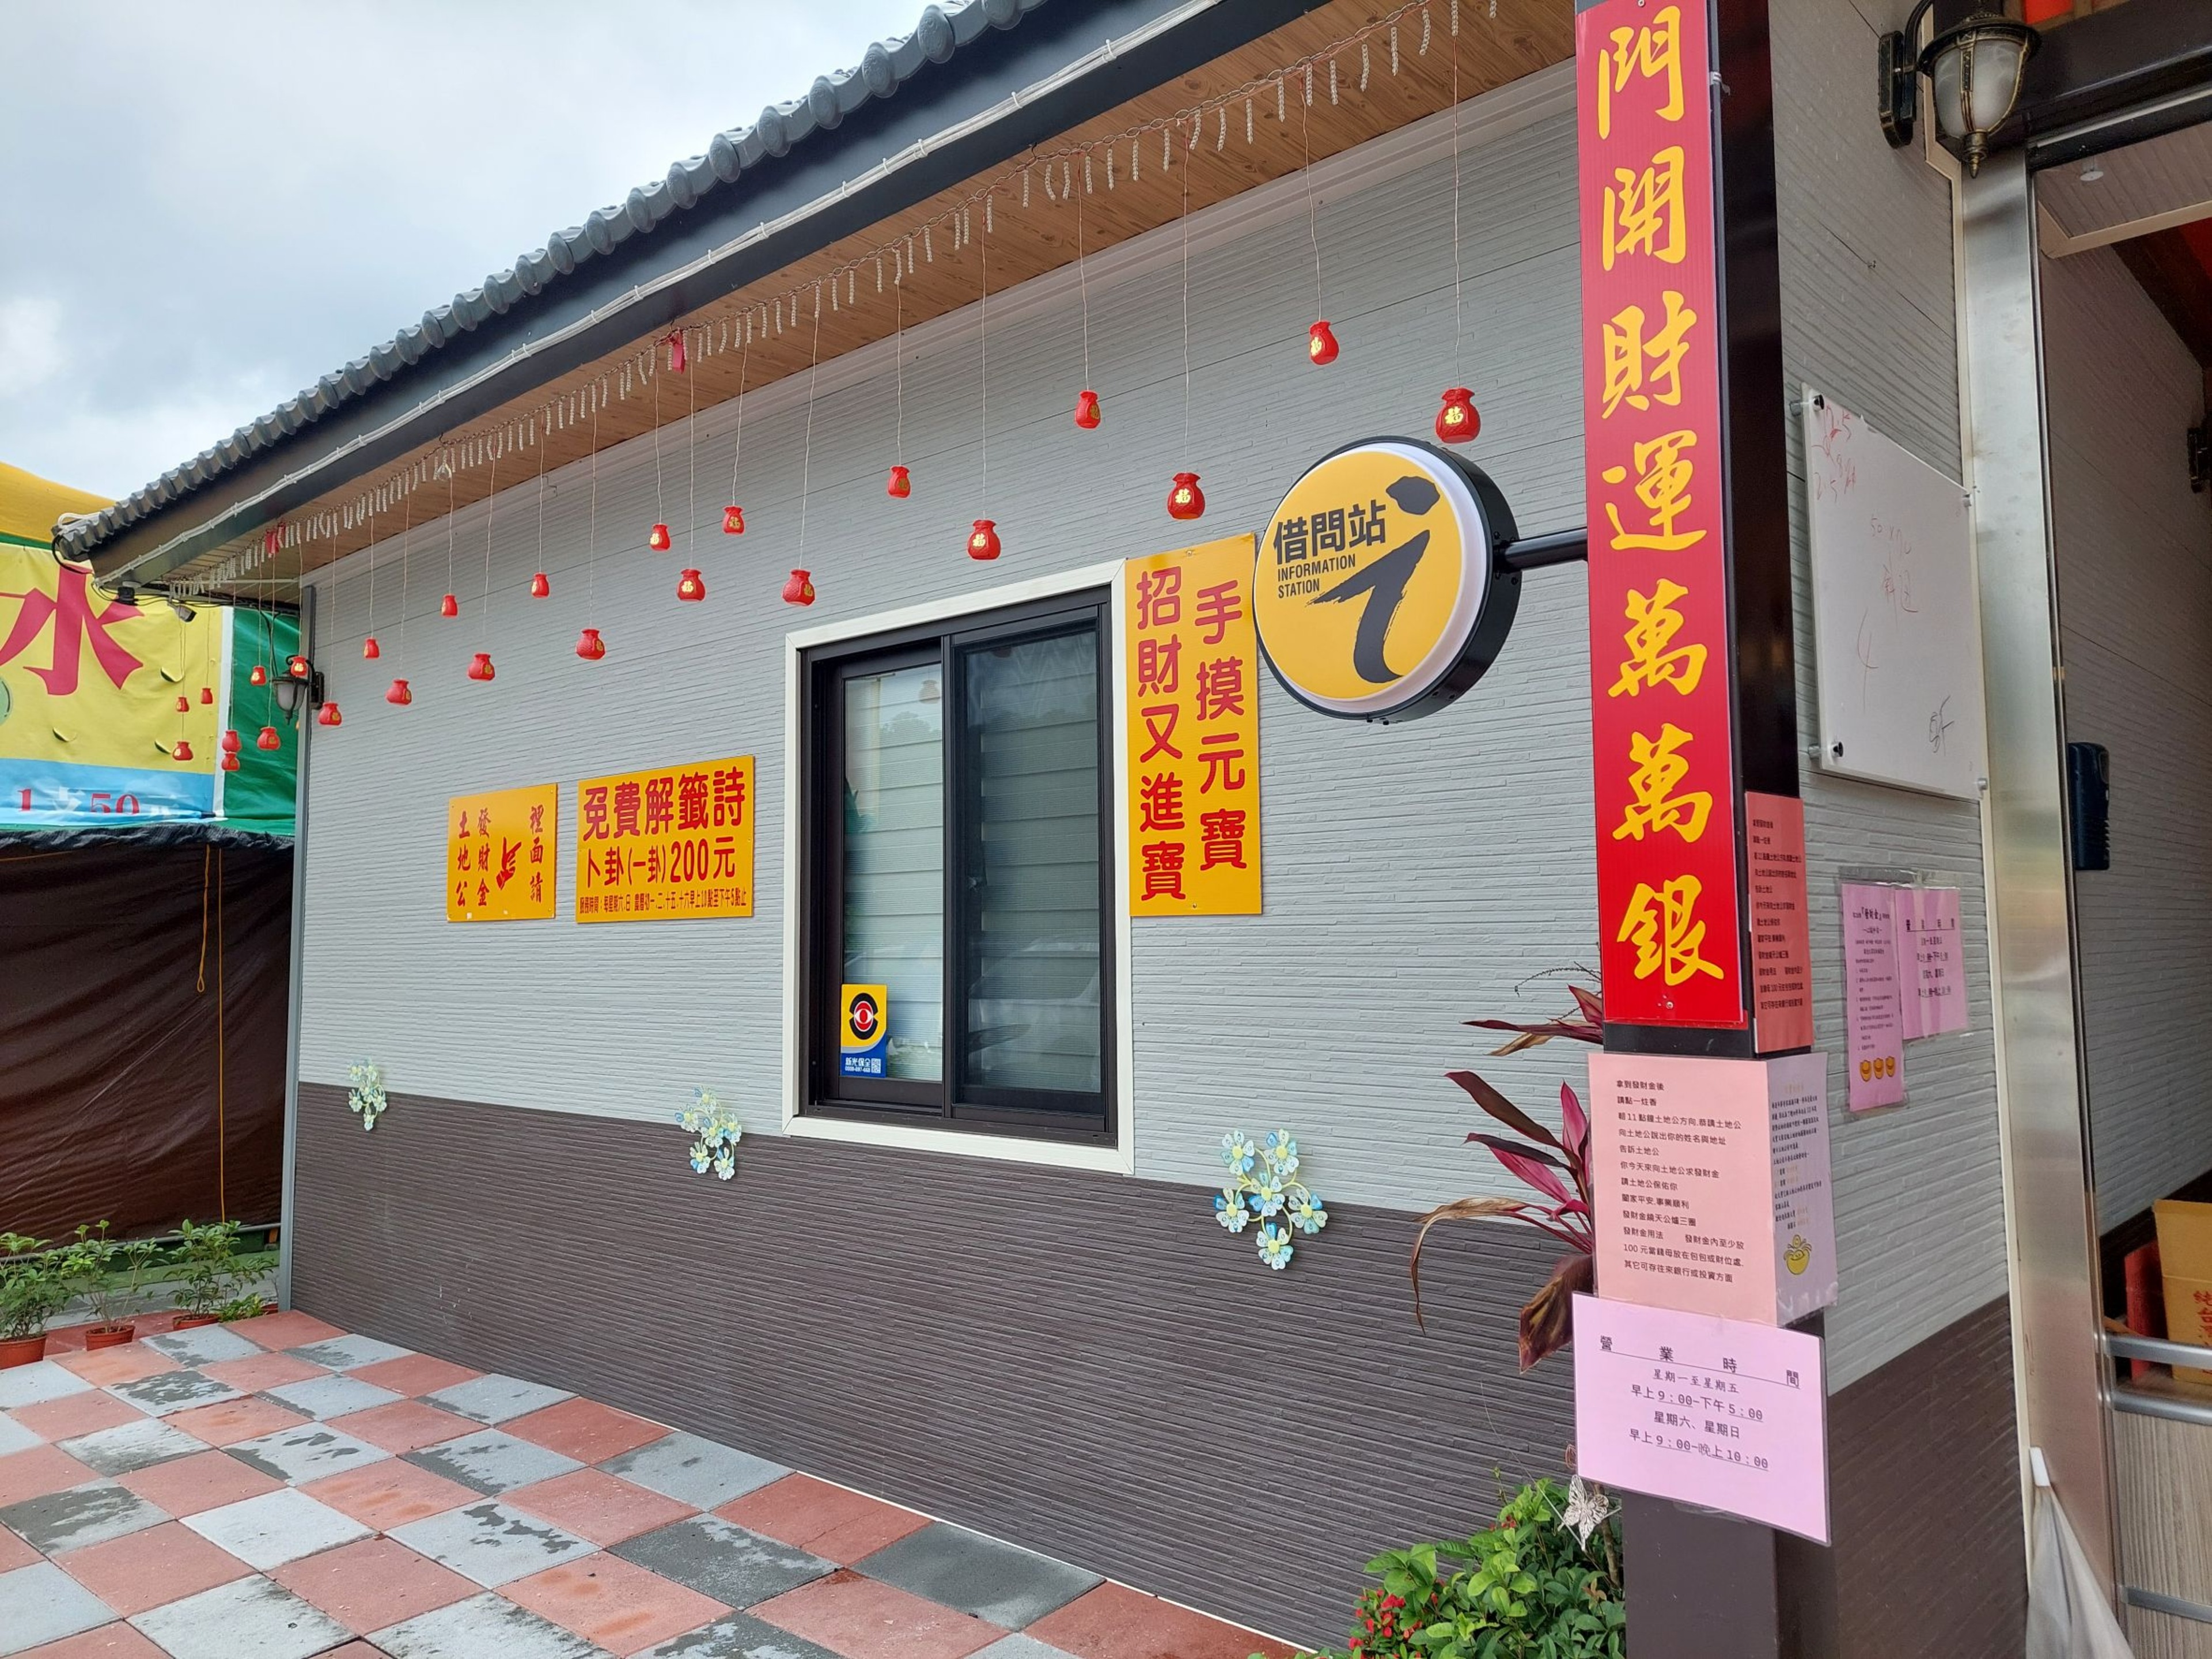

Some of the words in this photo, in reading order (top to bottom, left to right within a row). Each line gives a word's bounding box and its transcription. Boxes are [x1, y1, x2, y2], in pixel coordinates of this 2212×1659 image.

[1598, 5, 1724, 987] 門開財運萬萬銀
[1273, 499, 1387, 565] 借問站
[1277, 554, 1356, 582] INFORMATION
[1278, 578, 1320, 599] STATION
[1136, 566, 1187, 902] 招財又進寶
[1194, 579, 1247, 872] 手摸元寶
[582, 766, 746, 842] 免費解籤詩
[455, 810, 471, 907] 土地公
[476, 807, 491, 907] 發財金
[1619, 1145, 1660, 1156] 告訴土地公
[1621, 1177, 1678, 1191] 請土地公保佑你
[1653, 1368, 1740, 1394] 星期一至星期五
[1654, 1410, 1741, 1439] 星期六、星期日
